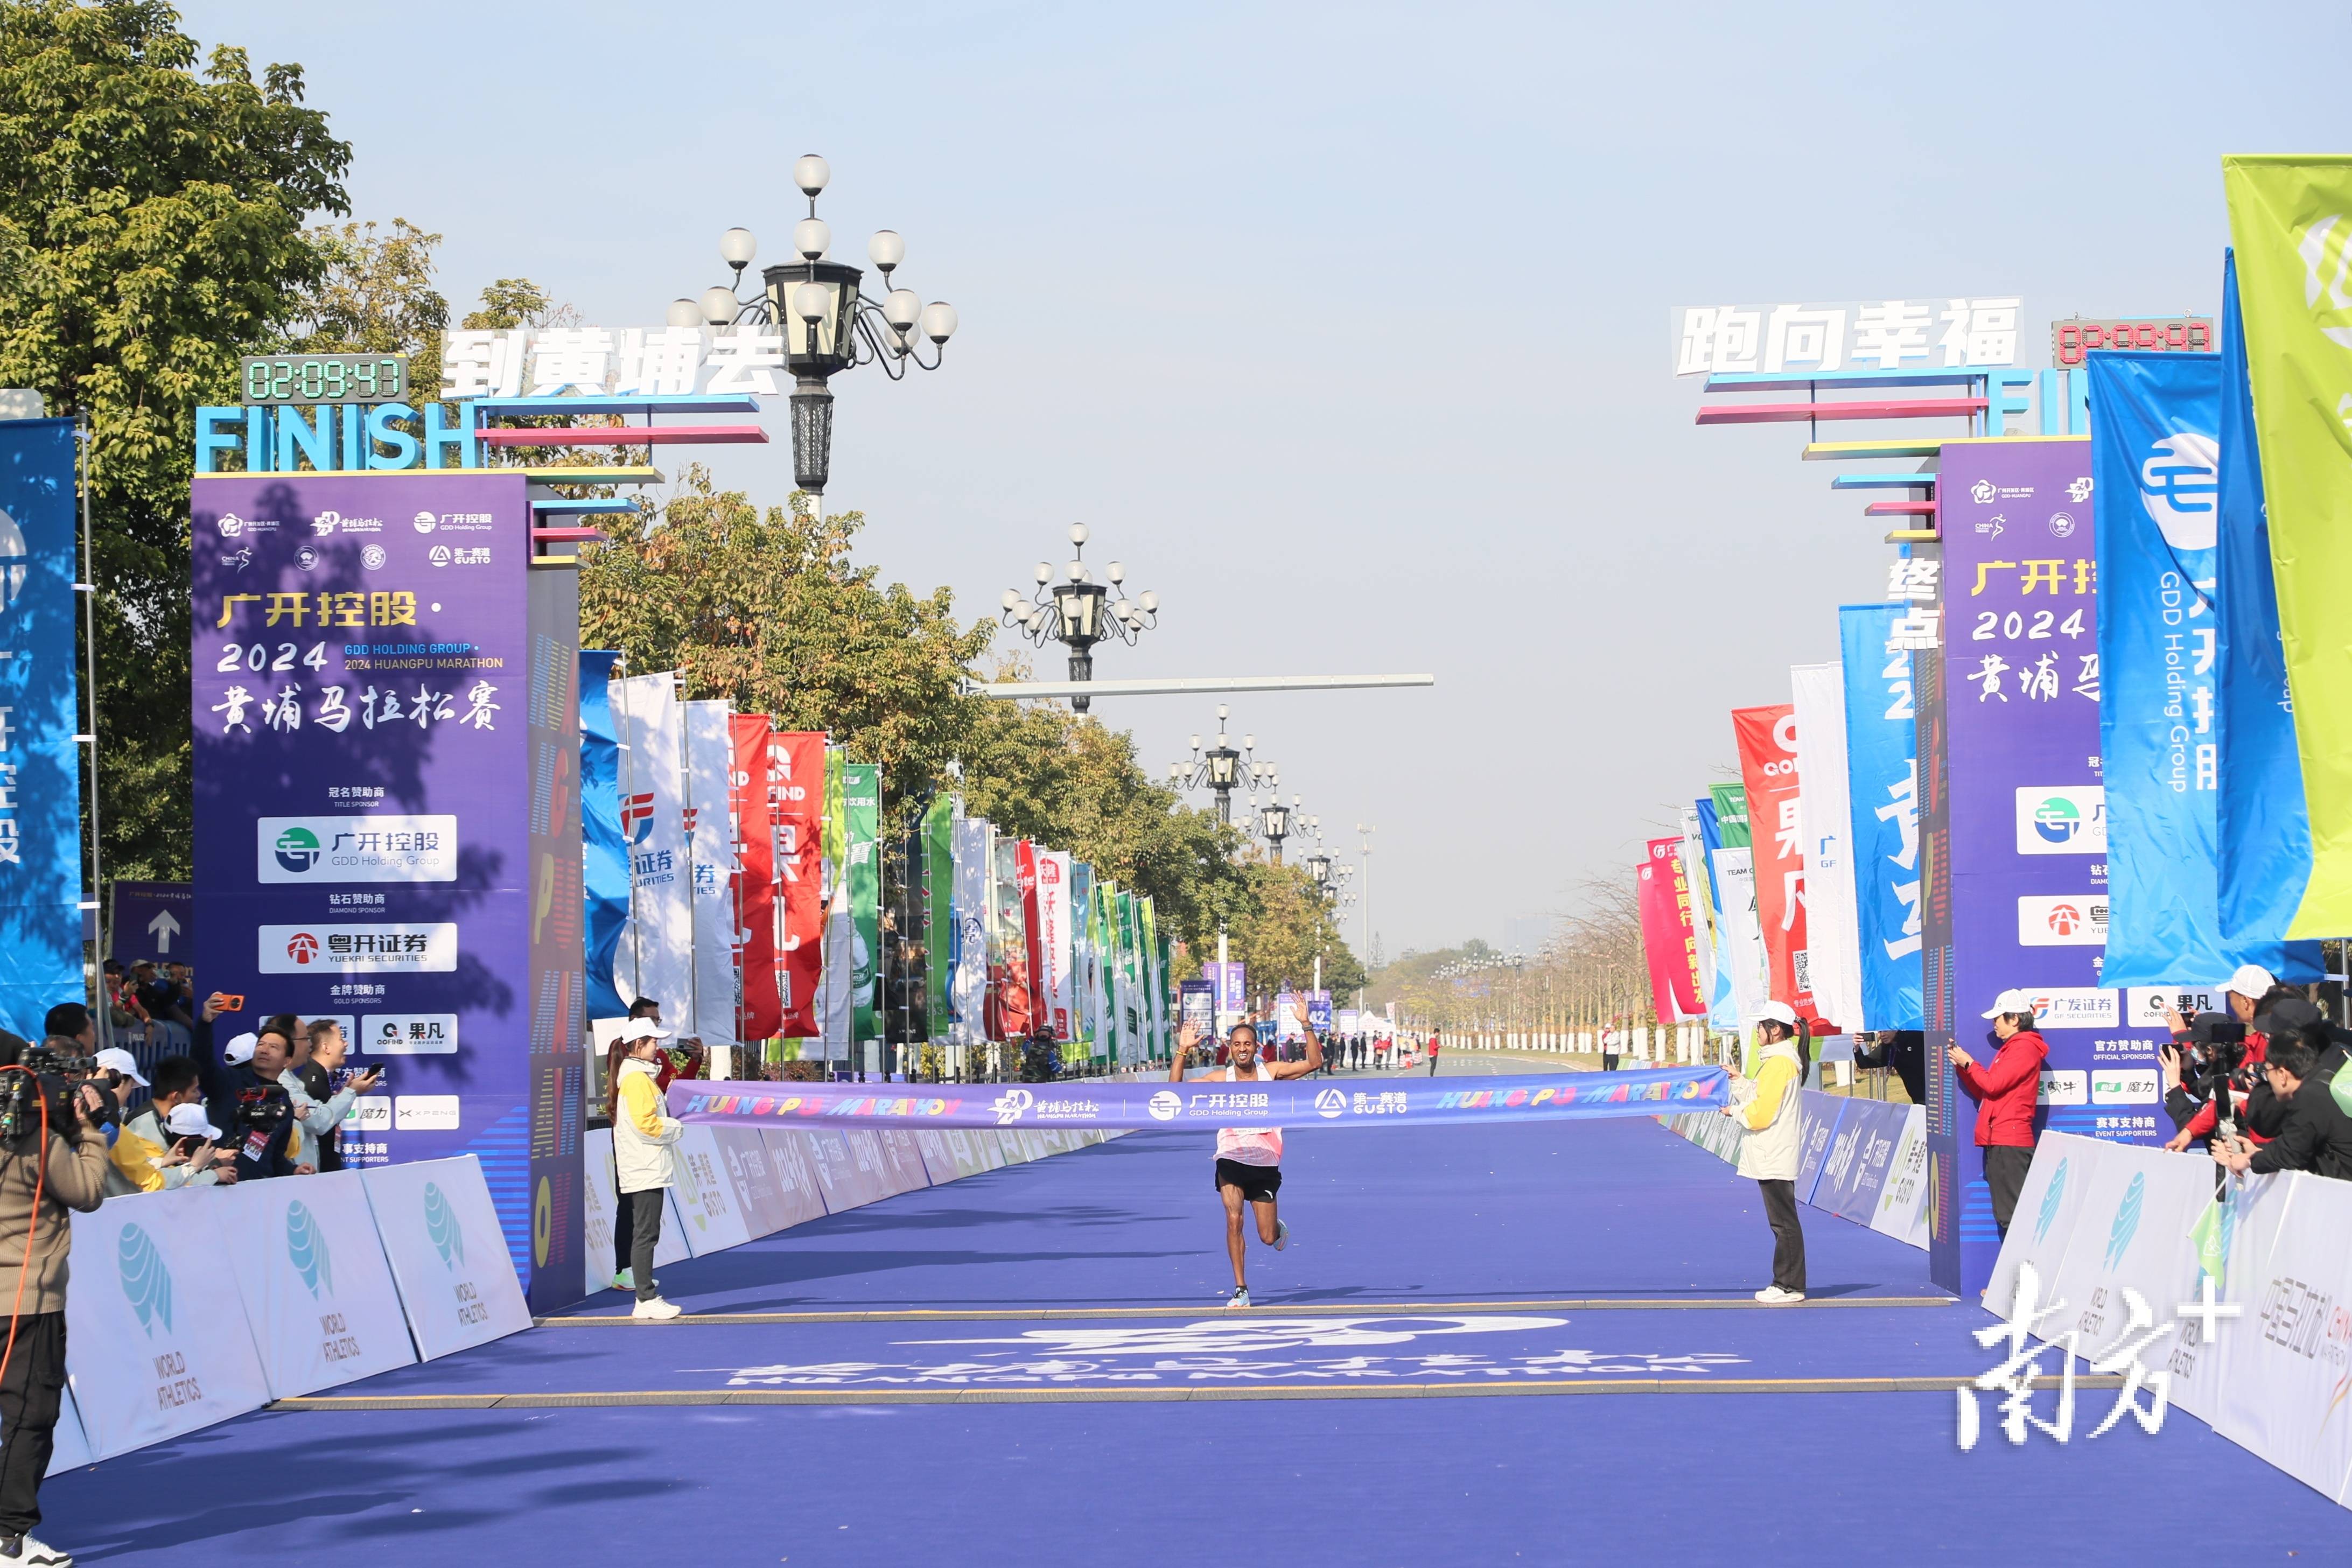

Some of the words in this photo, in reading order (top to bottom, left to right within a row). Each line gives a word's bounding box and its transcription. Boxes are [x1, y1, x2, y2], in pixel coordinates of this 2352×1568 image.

[1675, 298, 2021, 376] 跑向幸福
[440, 326, 786, 398] 到黄埔去
[195, 401, 480, 472] FINISH
[440, 513, 492, 524] 广开控股
[454, 547, 491, 557] 第一赛道
[454, 556, 491, 564] GUSTO
[1887, 558, 1940, 650] 终点
[2160, 571, 2182, 626] GDD
[216, 591, 417, 629] 广开控股
[1972, 608, 2085, 641] 2024
[216, 641, 327, 673] 2024
[345, 645, 369, 655] GDD
[373, 644, 426, 654] HOLDING
[429, 643, 470, 653] GROUP
[345, 660, 371, 670] 2024
[375, 659, 433, 669] HUANGPU
[437, 657, 503, 668] MARATHON
[2164, 634, 2186, 718] Holding
[211, 680, 501, 734] 黄埔马拉松赛
[2167, 725, 2189, 793] Group
[328, 787, 385, 797] 冠名赞助商
[331, 832, 439, 852] 广开控股
[331, 856, 358, 866] GDD
[361, 855, 403, 867] Holding
[406, 856, 439, 867] Group
[1727, 868, 1748, 876] TEAM
[330, 893, 385, 905] 钻石赞助商
[327, 934, 428, 953] 粤开证券
[330, 984, 386, 996] 金牌赞助商
[2054, 998, 2112, 1012] 广发证券
[2177, 995, 2213, 1011] 果凡
[409, 1023, 445, 1040] 果凡
[2094, 1040, 2153, 1051] 官方赞助商
[2048, 1081, 2077, 1095] 蒙牛
[2127, 1081, 2155, 1093] 魔力
[685, 1095, 774, 1116] HUANG
[776, 1098, 824, 1116] PU
[1189, 1094, 1268, 1108] 广开控股
[1353, 1091, 1407, 1105] 第一赛道
[1436, 1089, 1528, 1109] HUANG
[1530, 1088, 1577, 1106] PU
[360, 1108, 387, 1119] 魔力
[1212, 1109, 1242, 1117] Holding
[1244, 1109, 1269, 1117] Group
[1354, 1105, 1407, 1115] GUSTO
[2096, 1117, 2155, 1129] 赛事支持商
[342, 1143, 388, 1154] 事支持商
[453, 1281, 477, 1304] WORLD
[457, 1301, 488, 1327] ATHLETICS
[319, 1313, 346, 1336] WORLD
[323, 1335, 361, 1363] ATHLETICS
[152, 1350, 186, 1380] WORLD
[157, 1377, 202, 1411] ATHLETICS
